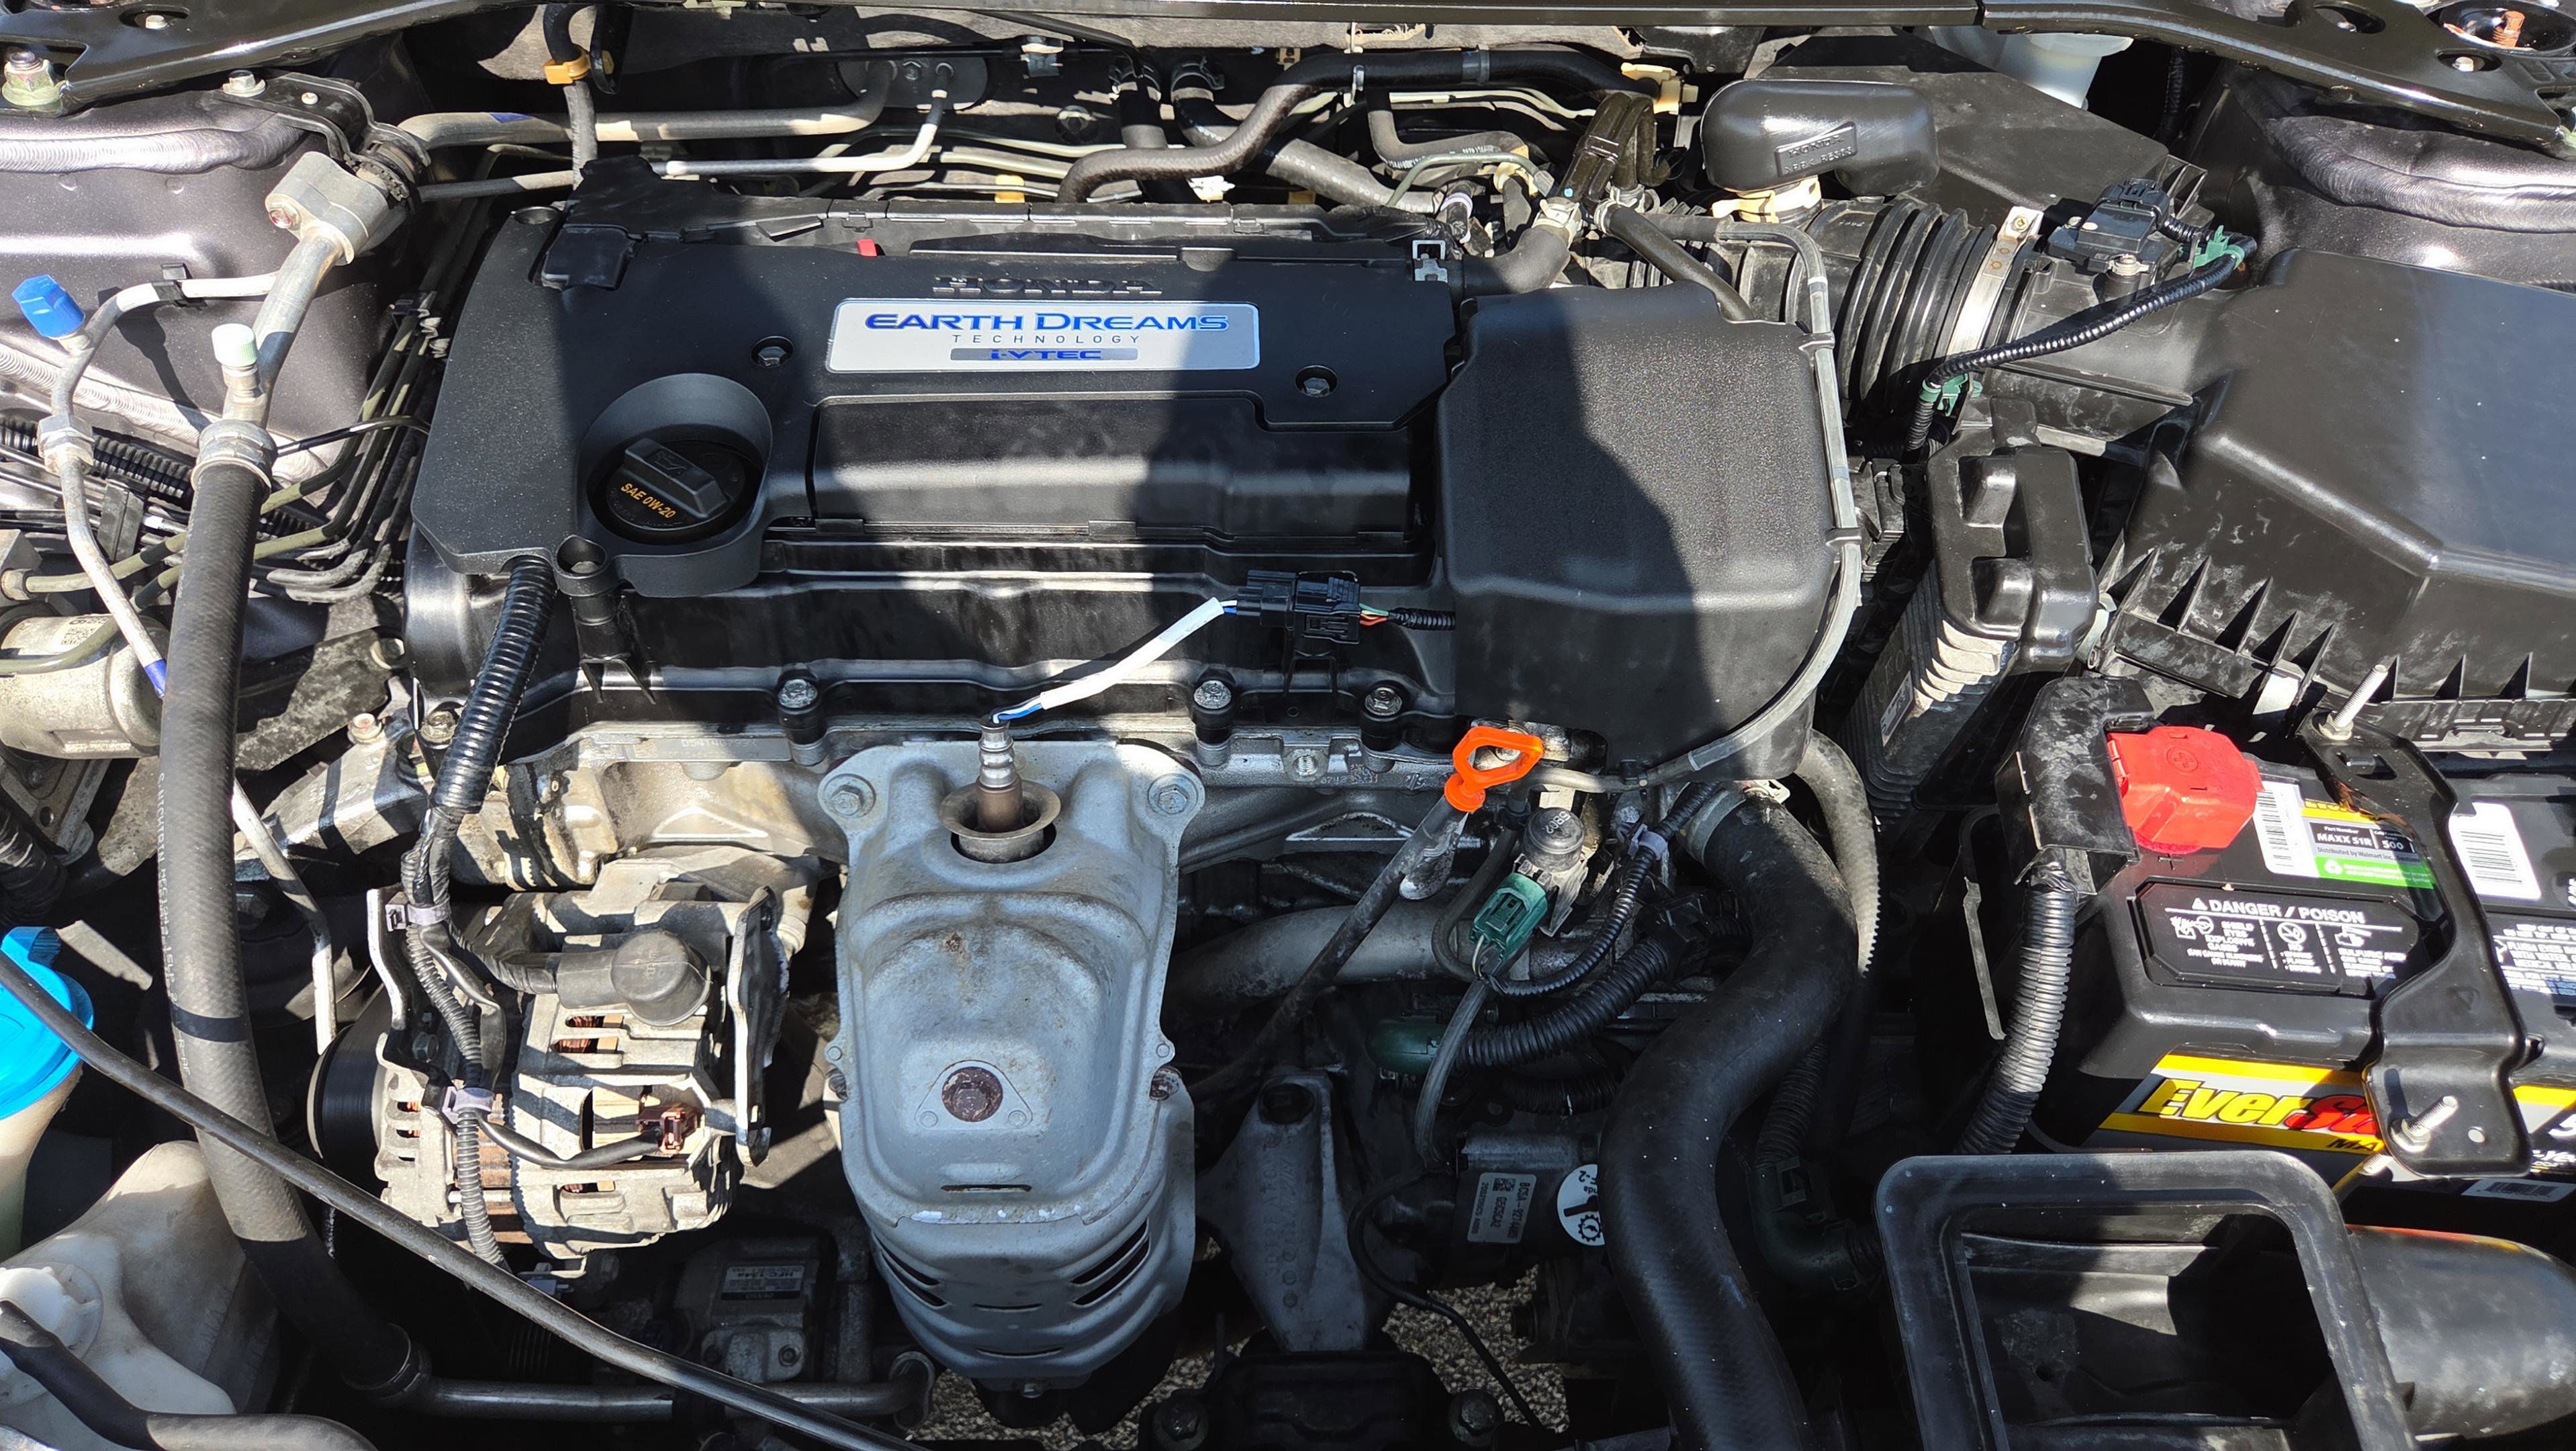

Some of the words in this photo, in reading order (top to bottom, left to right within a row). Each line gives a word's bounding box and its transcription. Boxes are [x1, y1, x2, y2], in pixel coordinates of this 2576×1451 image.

[932, 276, 1162, 294] HONDA
[864, 312, 1023, 331] EARTH
[952, 334, 1140, 344] TECHNOLOGY
[989, 348, 1102, 360] i-VTEC
[620, 482, 647, 501] SAE
[642, 495, 676, 519] 0W-20
[2317, 832, 2351, 844] MAXX
[2352, 836, 2373, 846] 51R
[2382, 840, 2404, 850] 500
[2317, 846, 2350, 856] Distributed
[2358, 850, 2383, 859] Walmart
[2208, 899, 2283, 918] DANGER
[2297, 907, 2366, 924] POISON
